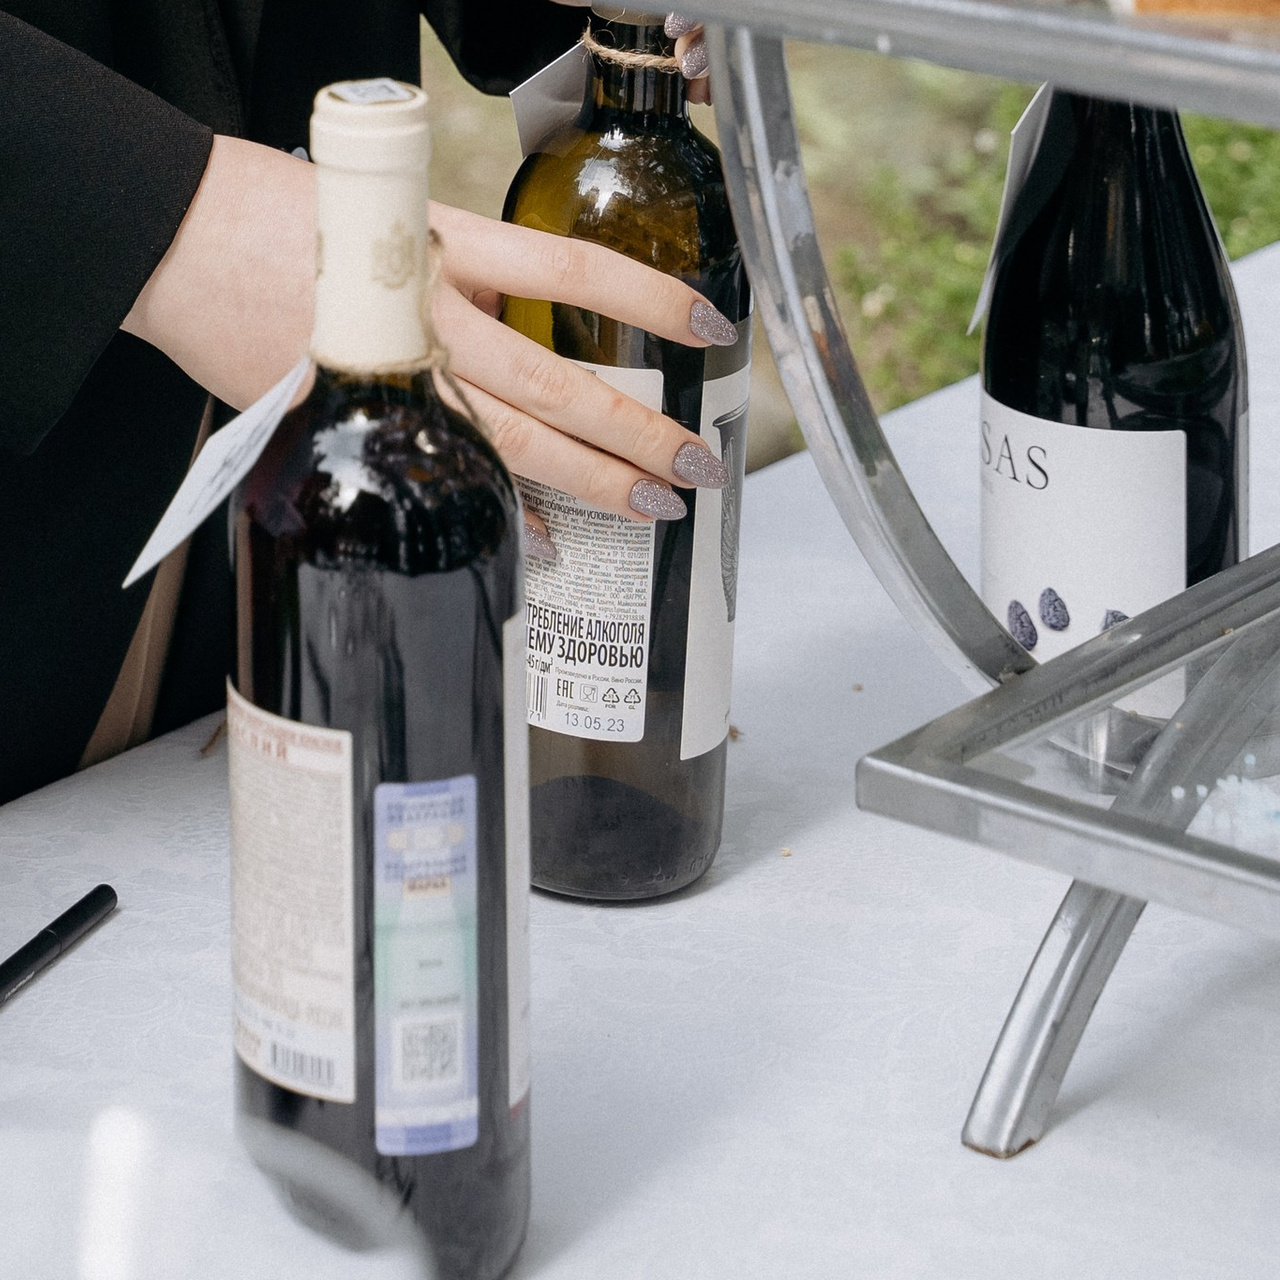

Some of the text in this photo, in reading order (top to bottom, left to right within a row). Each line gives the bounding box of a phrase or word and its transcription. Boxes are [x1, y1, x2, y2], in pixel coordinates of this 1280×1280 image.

[981, 421, 1049, 490] SAS
[533, 497, 545, 508] при
[545, 499, 586, 518] соблюдении
[586, 619, 645, 644] АЛКОГОЛЯ
[527, 626, 643, 668] ЕМУ ЗДОРОВЬЮ
[565, 712, 625, 732] 13.05.23
